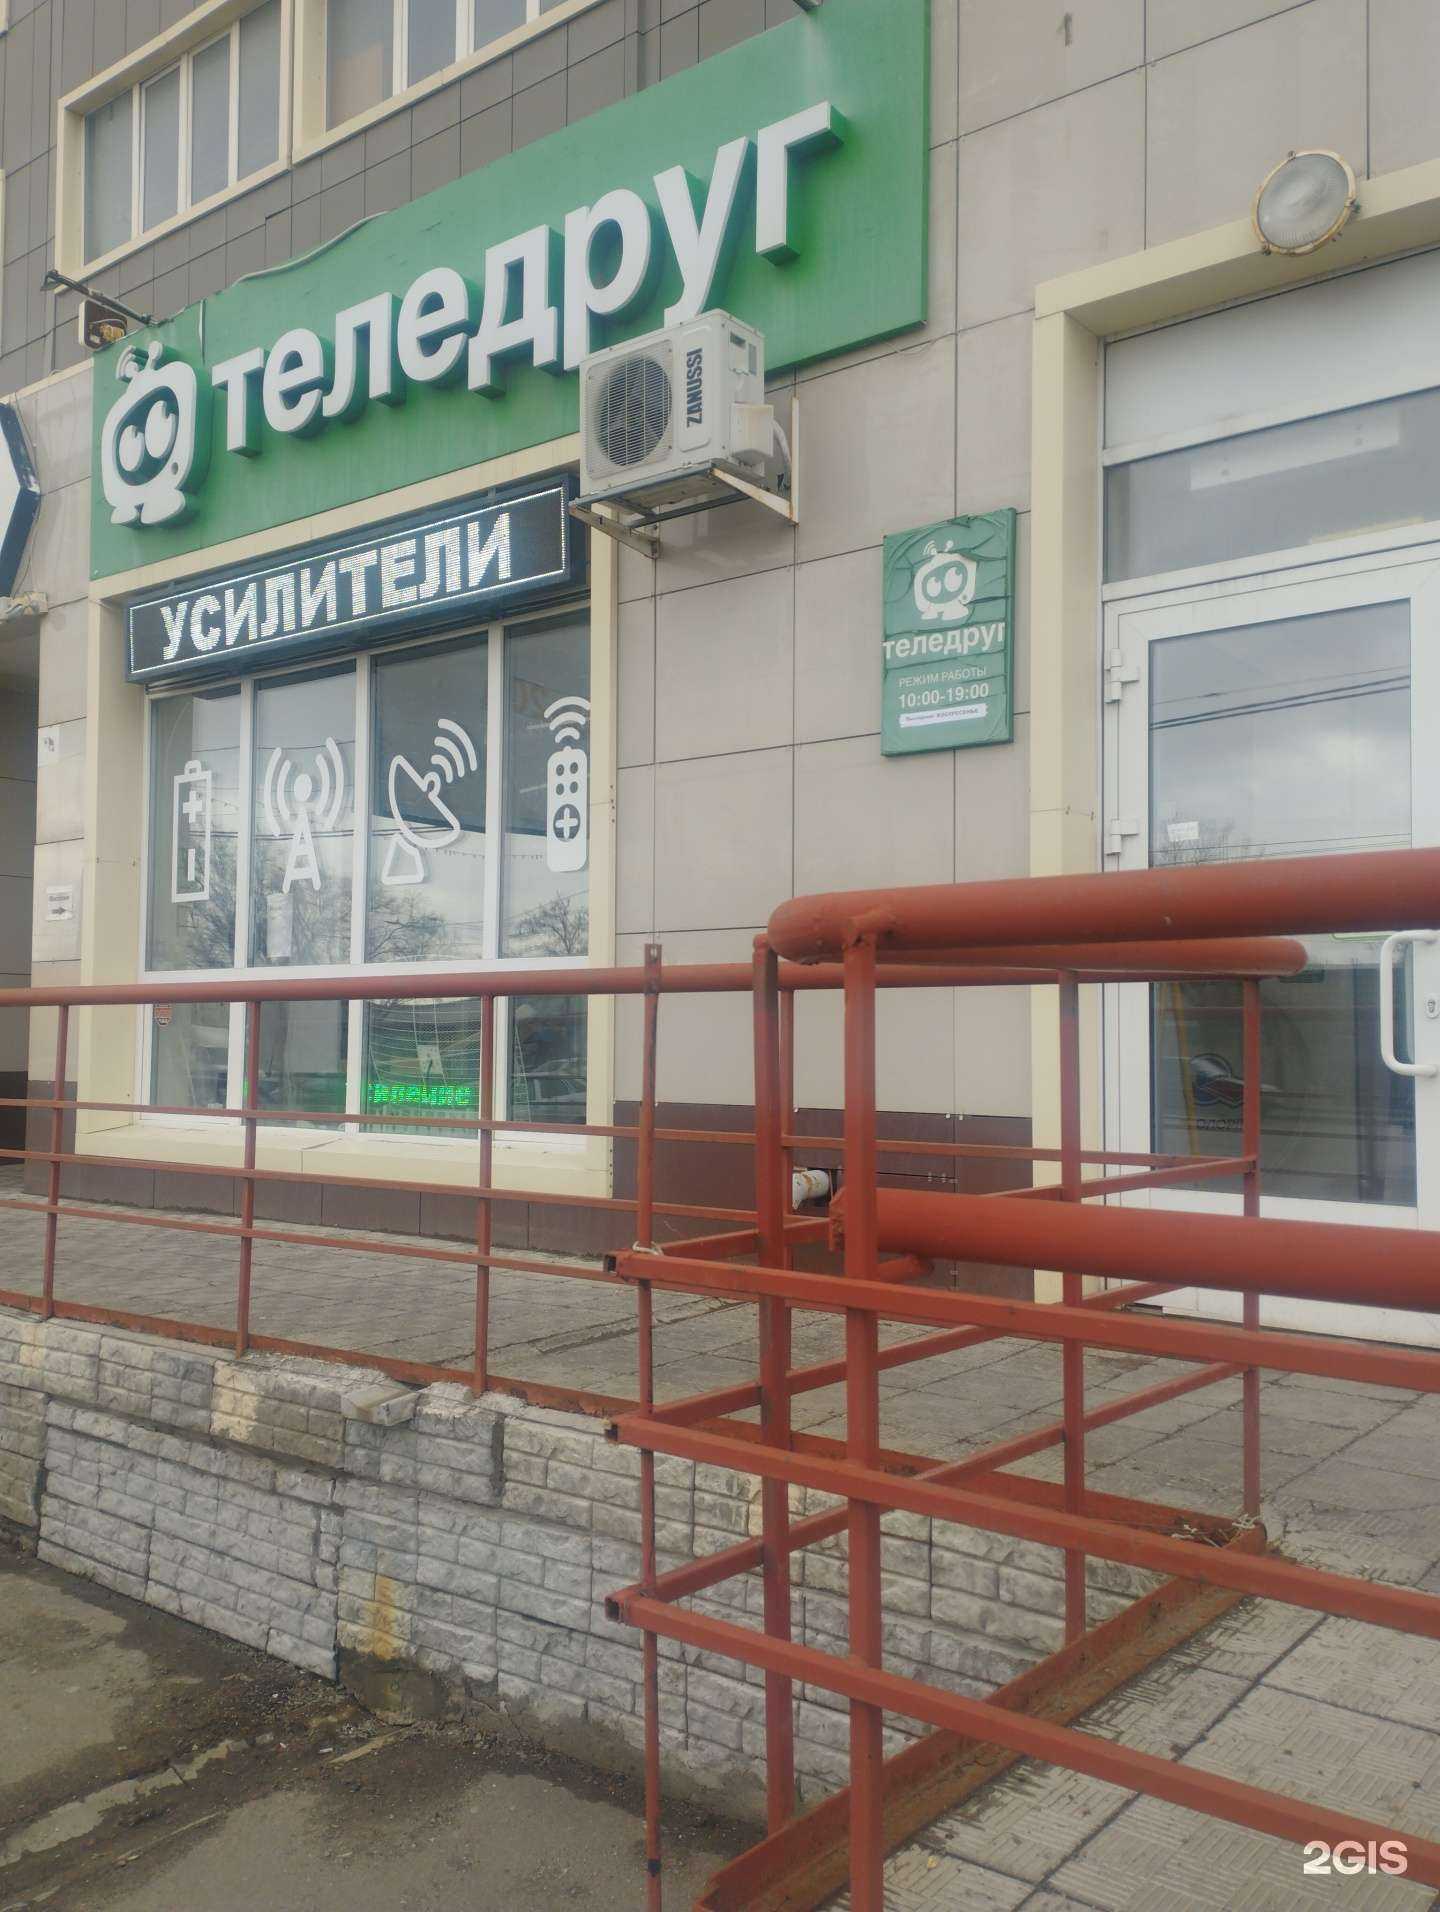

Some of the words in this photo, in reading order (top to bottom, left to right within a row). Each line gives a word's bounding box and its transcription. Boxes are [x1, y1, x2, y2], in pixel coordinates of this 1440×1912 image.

[211, 101, 836, 457] теледруг
[686, 348, 703, 428] ZANUSSI
[160, 512, 512, 660] УСИЛИТЕЛИ
[883, 622, 1005, 659] теледруг
[898, 683, 989, 708] 10:00-19:00
[899, 672, 939, 688] РЕЖИМ
[941, 666, 987, 682] РАБОТЫ
